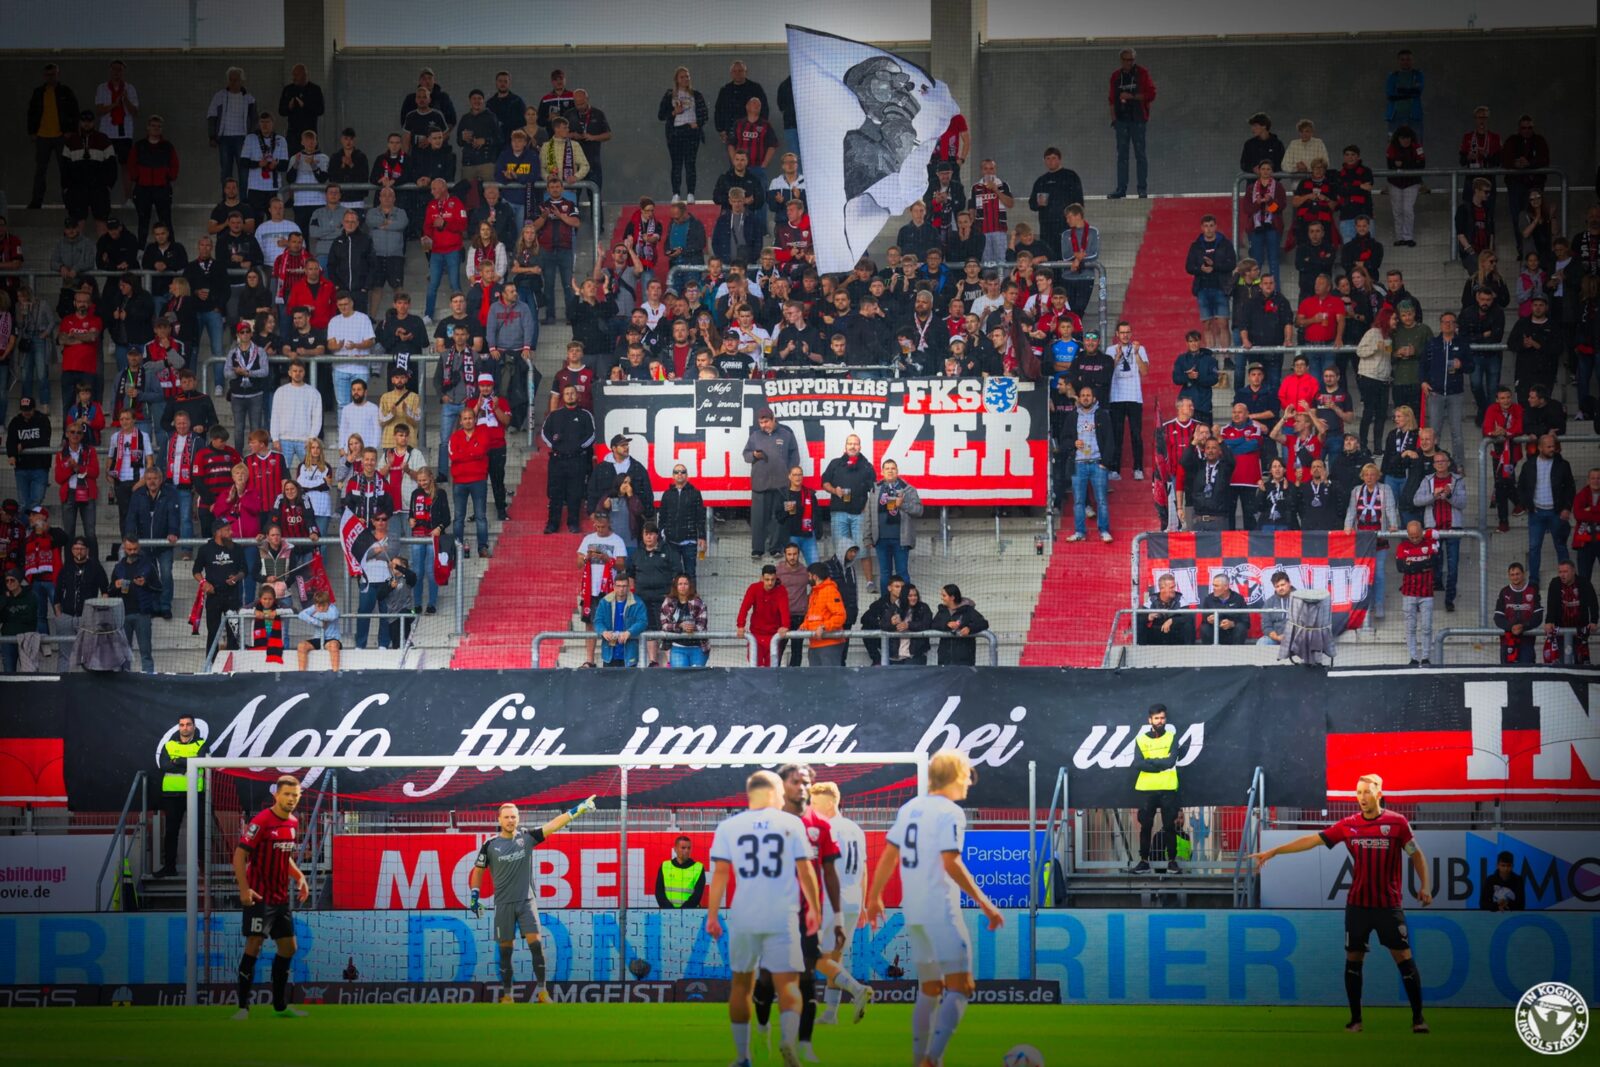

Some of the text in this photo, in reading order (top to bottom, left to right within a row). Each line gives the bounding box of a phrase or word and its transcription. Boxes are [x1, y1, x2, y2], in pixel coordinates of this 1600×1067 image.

[765, 378, 888, 396] SUPPORTERS
[907, 380, 981, 411] FKS
[768, 401, 886, 419] INGOLSTADT
[17, 427, 40, 440] VANS
[155, 692, 391, 797] Mofo
[402, 692, 567, 797] für
[617, 706, 858, 770] immer
[914, 695, 1027, 769] bei
[737, 833, 784, 878] 33
[845, 840, 858, 875] 11
[902, 823, 918, 869] 9
[250, 917, 263, 932] 16
[338, 986, 475, 1005] hildeGUARD
